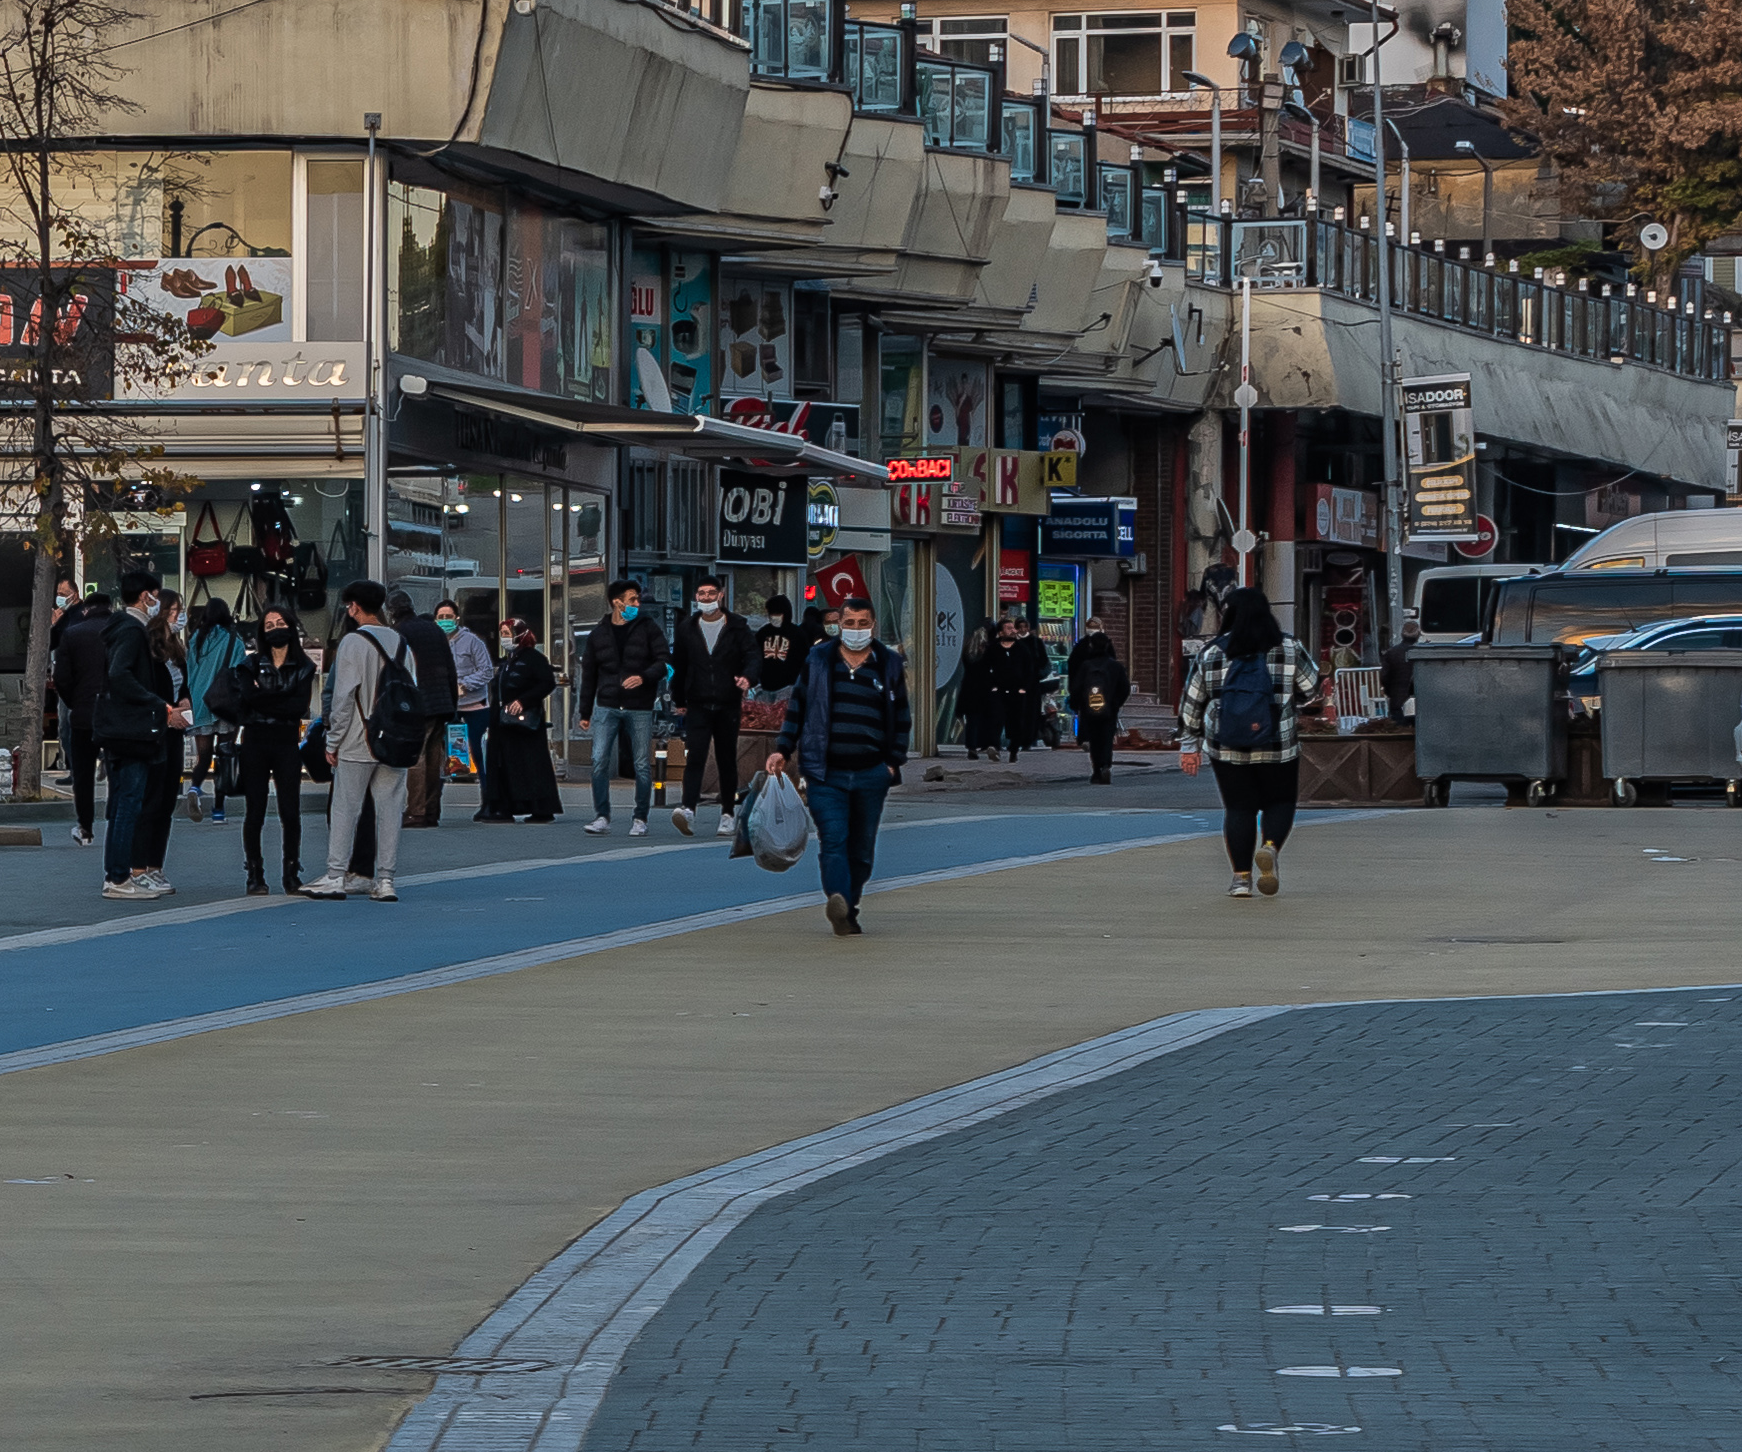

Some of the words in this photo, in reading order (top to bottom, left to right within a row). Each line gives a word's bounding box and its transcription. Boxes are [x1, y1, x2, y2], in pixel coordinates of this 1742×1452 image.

[176, 351, 351, 388] anta
[1045, 516, 1108, 526] ANADOLU
[723, 529, 766, 552] Dünyası
[1052, 527, 1108, 539] SİGORTA
